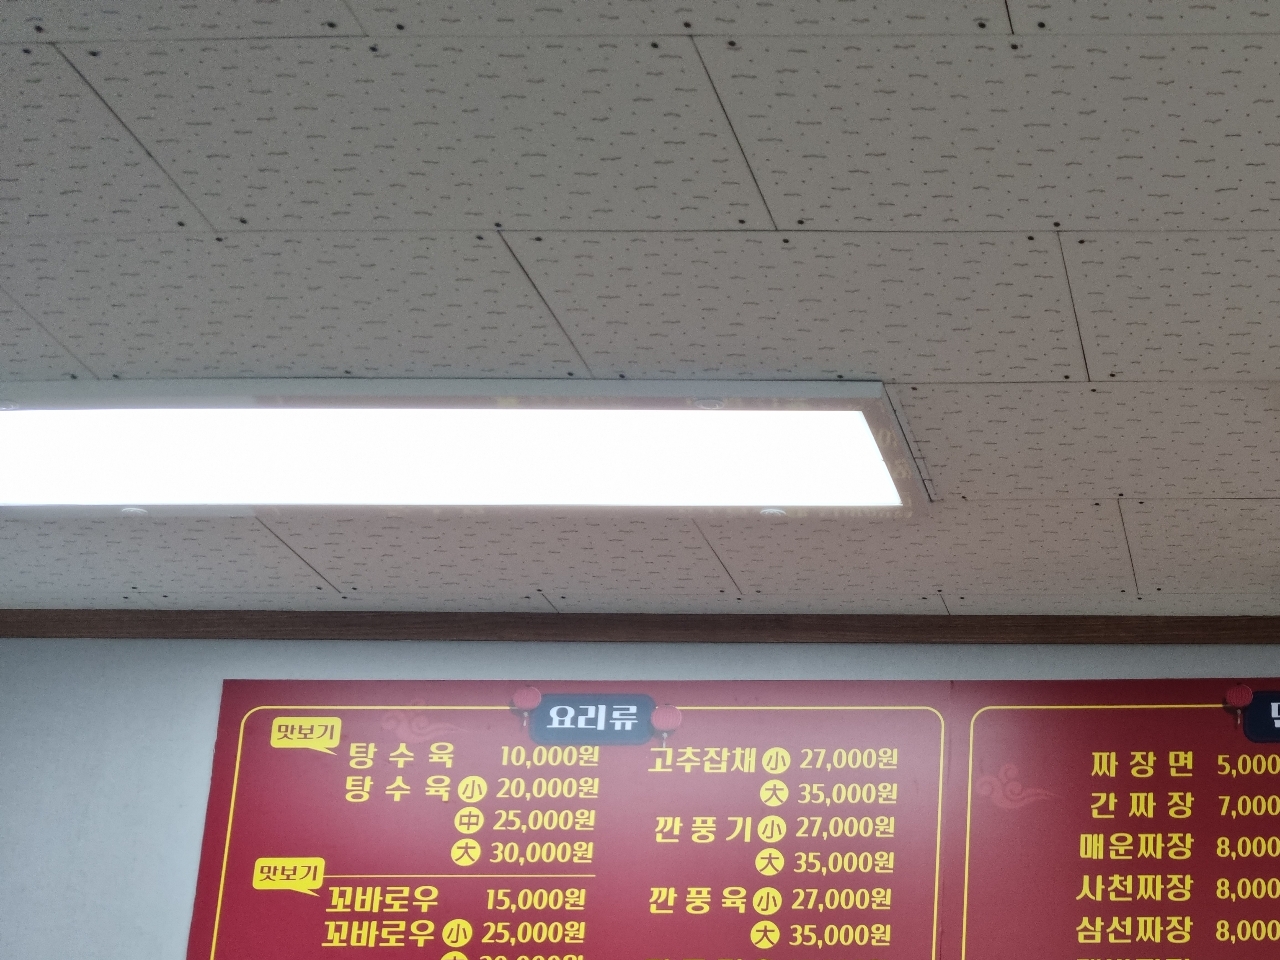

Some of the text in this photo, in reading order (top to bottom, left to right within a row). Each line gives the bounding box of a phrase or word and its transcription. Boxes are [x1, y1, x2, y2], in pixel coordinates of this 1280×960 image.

[546, 704, 639, 731] 요리류
[277, 723, 336, 741] 맛보기
[502, 745, 600, 769] 10,000원
[647, 746, 898, 774] 고추잡채 27,000원
[496, 776, 600, 801] 20,000원
[799, 782, 898, 807] 35,000원
[492, 809, 596, 833] 25,000원
[795, 815, 895, 840] 27,000원
[489, 841, 594, 866] 30,000원
[1079, 832, 1195, 860] 매운짜장
[258, 864, 318, 882] 맛보기
[793, 851, 895, 876] 35,000원
[325, 885, 587, 914] 꼬바로우 15,000원
[791, 887, 892, 913] 27,000원
[1075, 873, 1195, 902] 사천짜장
[321, 919, 586, 948] 꼬바로우 25,000원
[788, 923, 891, 950] 35,000원
[1075, 915, 1194, 944] 삼선짜장
